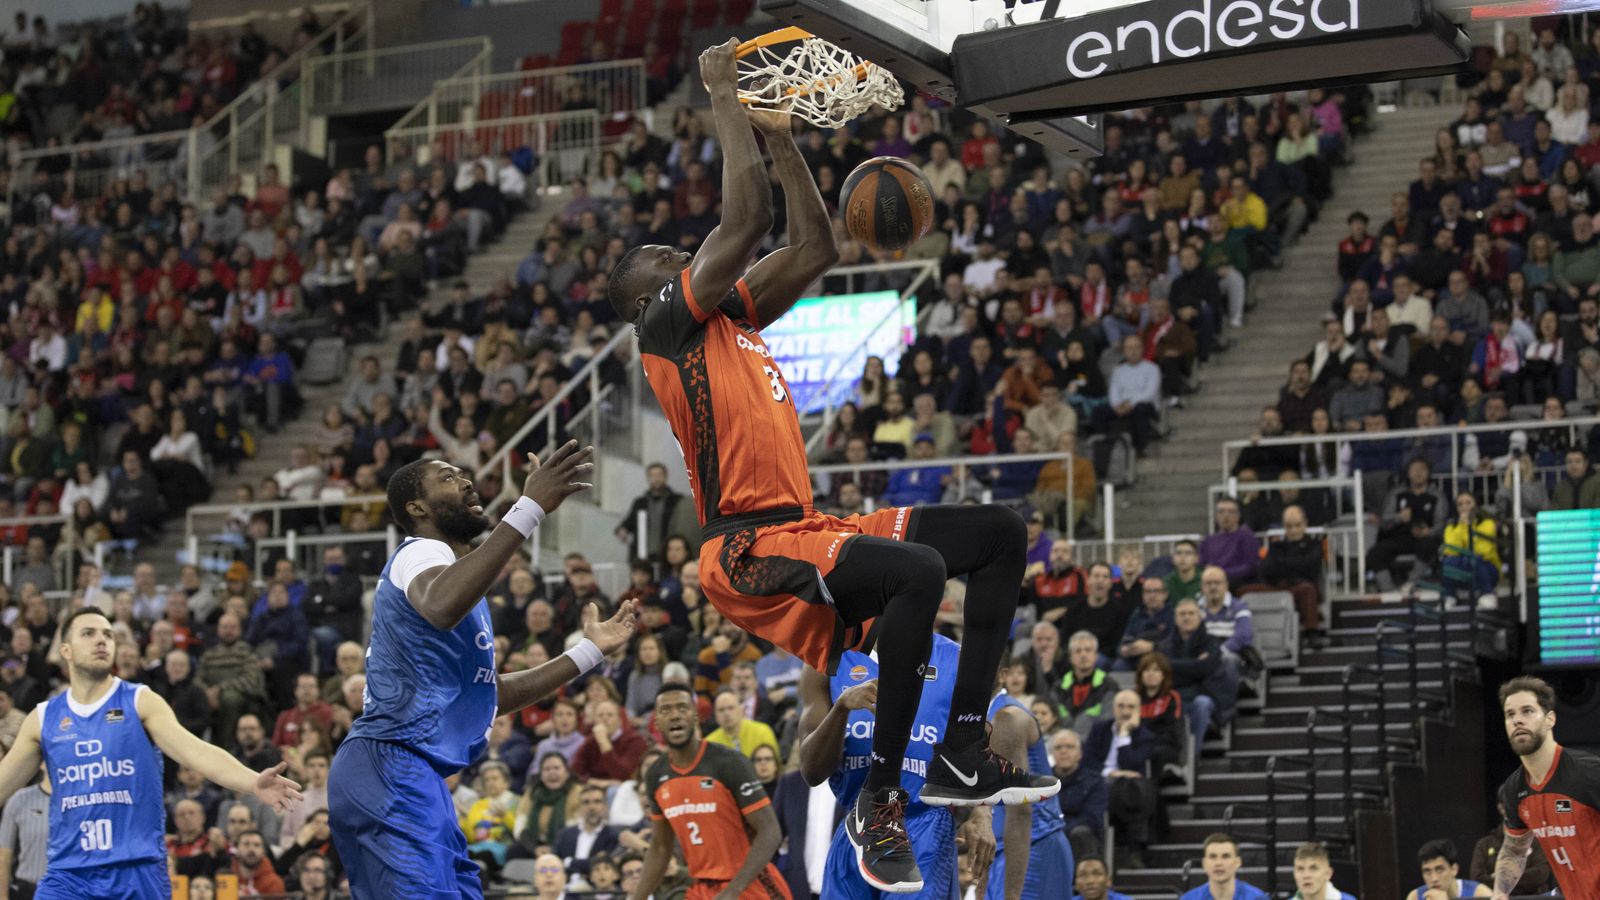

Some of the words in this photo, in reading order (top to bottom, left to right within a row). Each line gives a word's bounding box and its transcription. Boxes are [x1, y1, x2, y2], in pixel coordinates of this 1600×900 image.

[1066, 0, 1359, 79] endesa
[957, 712, 982, 723] vive
[57, 756, 135, 787] carplus
[61, 790, 133, 813] FUENLABRADA
[80, 818, 113, 852] 30
[687, 821, 704, 845] 2
[1552, 846, 1575, 871] 4
